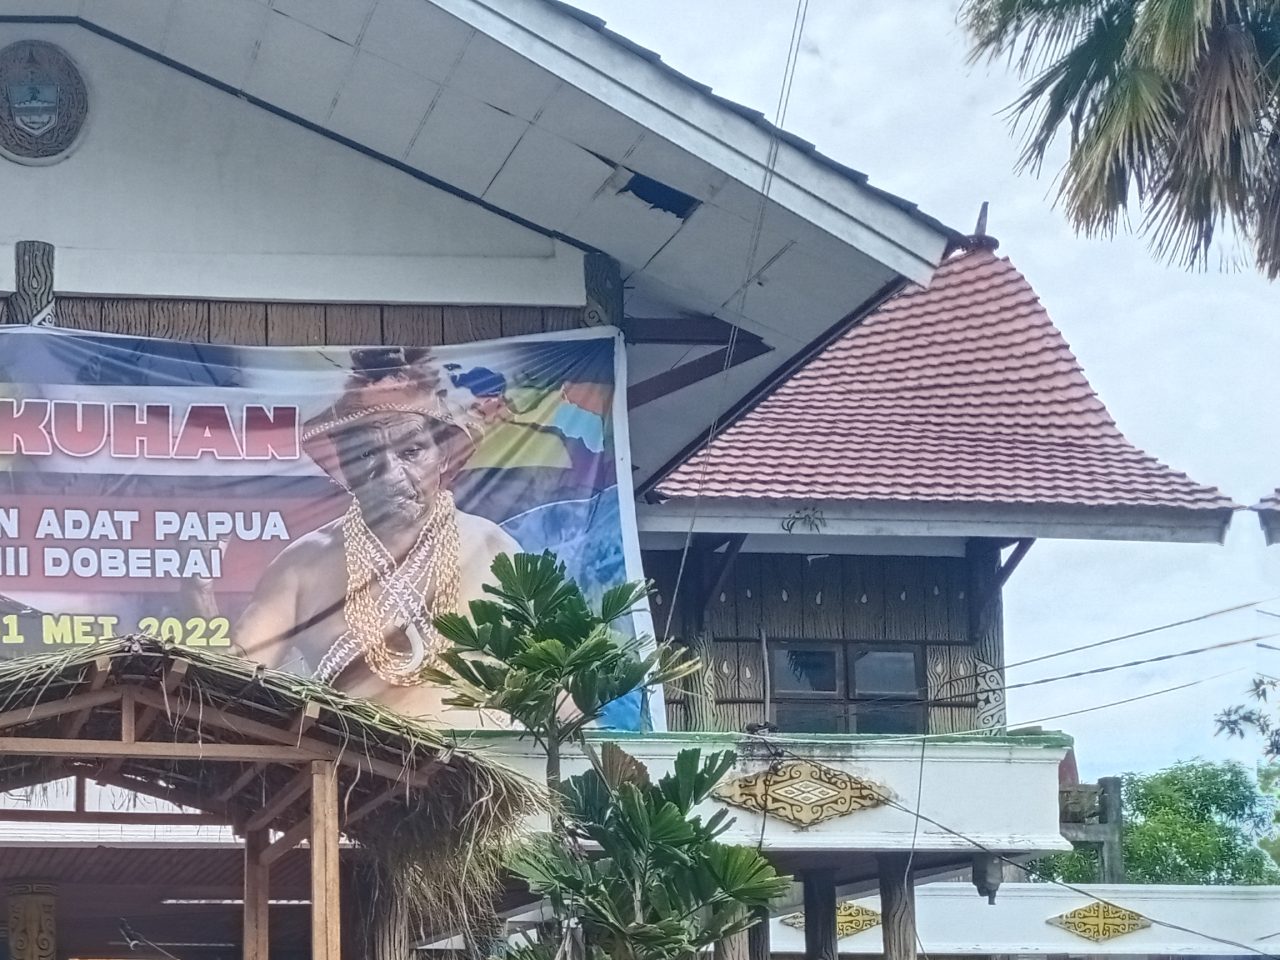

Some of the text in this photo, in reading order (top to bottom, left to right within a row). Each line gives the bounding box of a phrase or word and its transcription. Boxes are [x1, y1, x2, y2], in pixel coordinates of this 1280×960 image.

[35, 509, 139, 540] ADAT
[155, 511, 290, 541] PAPUA
[44, 547, 222, 578] DOBERAI
[42, 614, 118, 645] MEI
[138, 616, 231, 647] 2022
